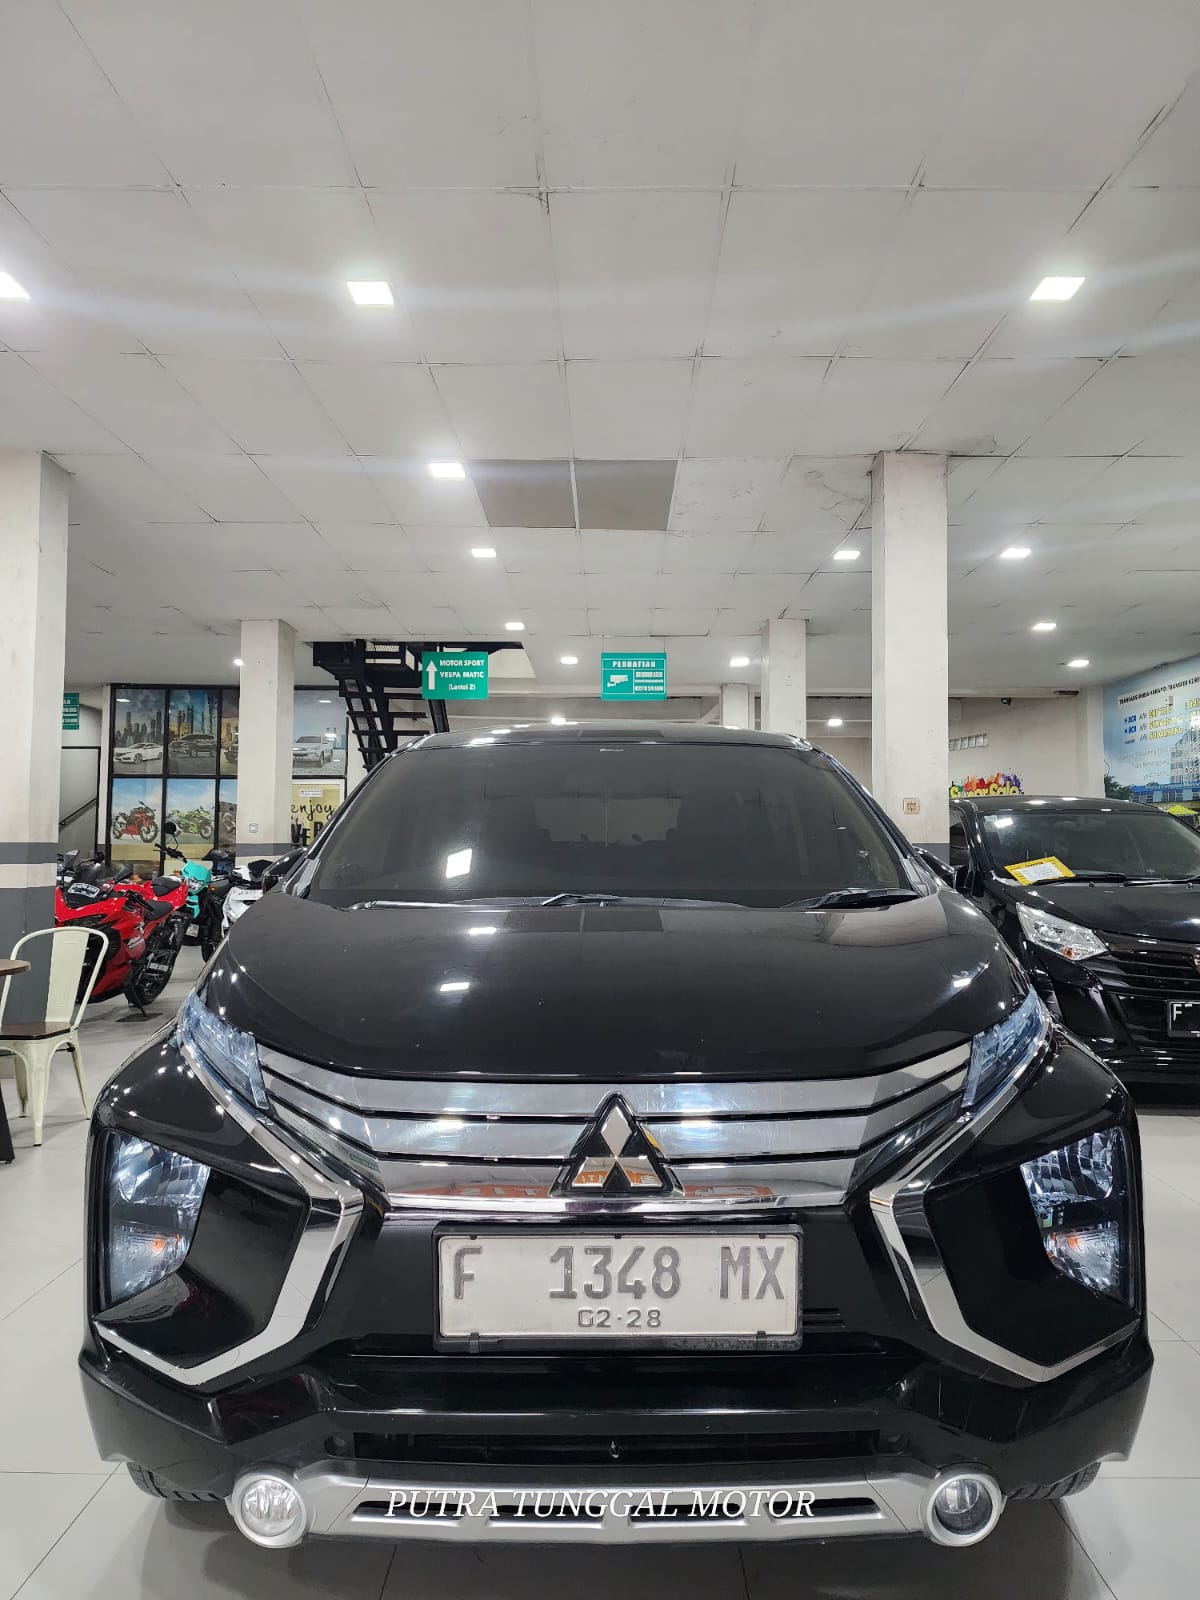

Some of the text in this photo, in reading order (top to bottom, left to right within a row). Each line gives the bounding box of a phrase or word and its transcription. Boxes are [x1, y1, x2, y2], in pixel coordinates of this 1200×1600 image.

[291, 800, 334, 821] enjoy
[453, 1246, 785, 1300] F 1348 MX
